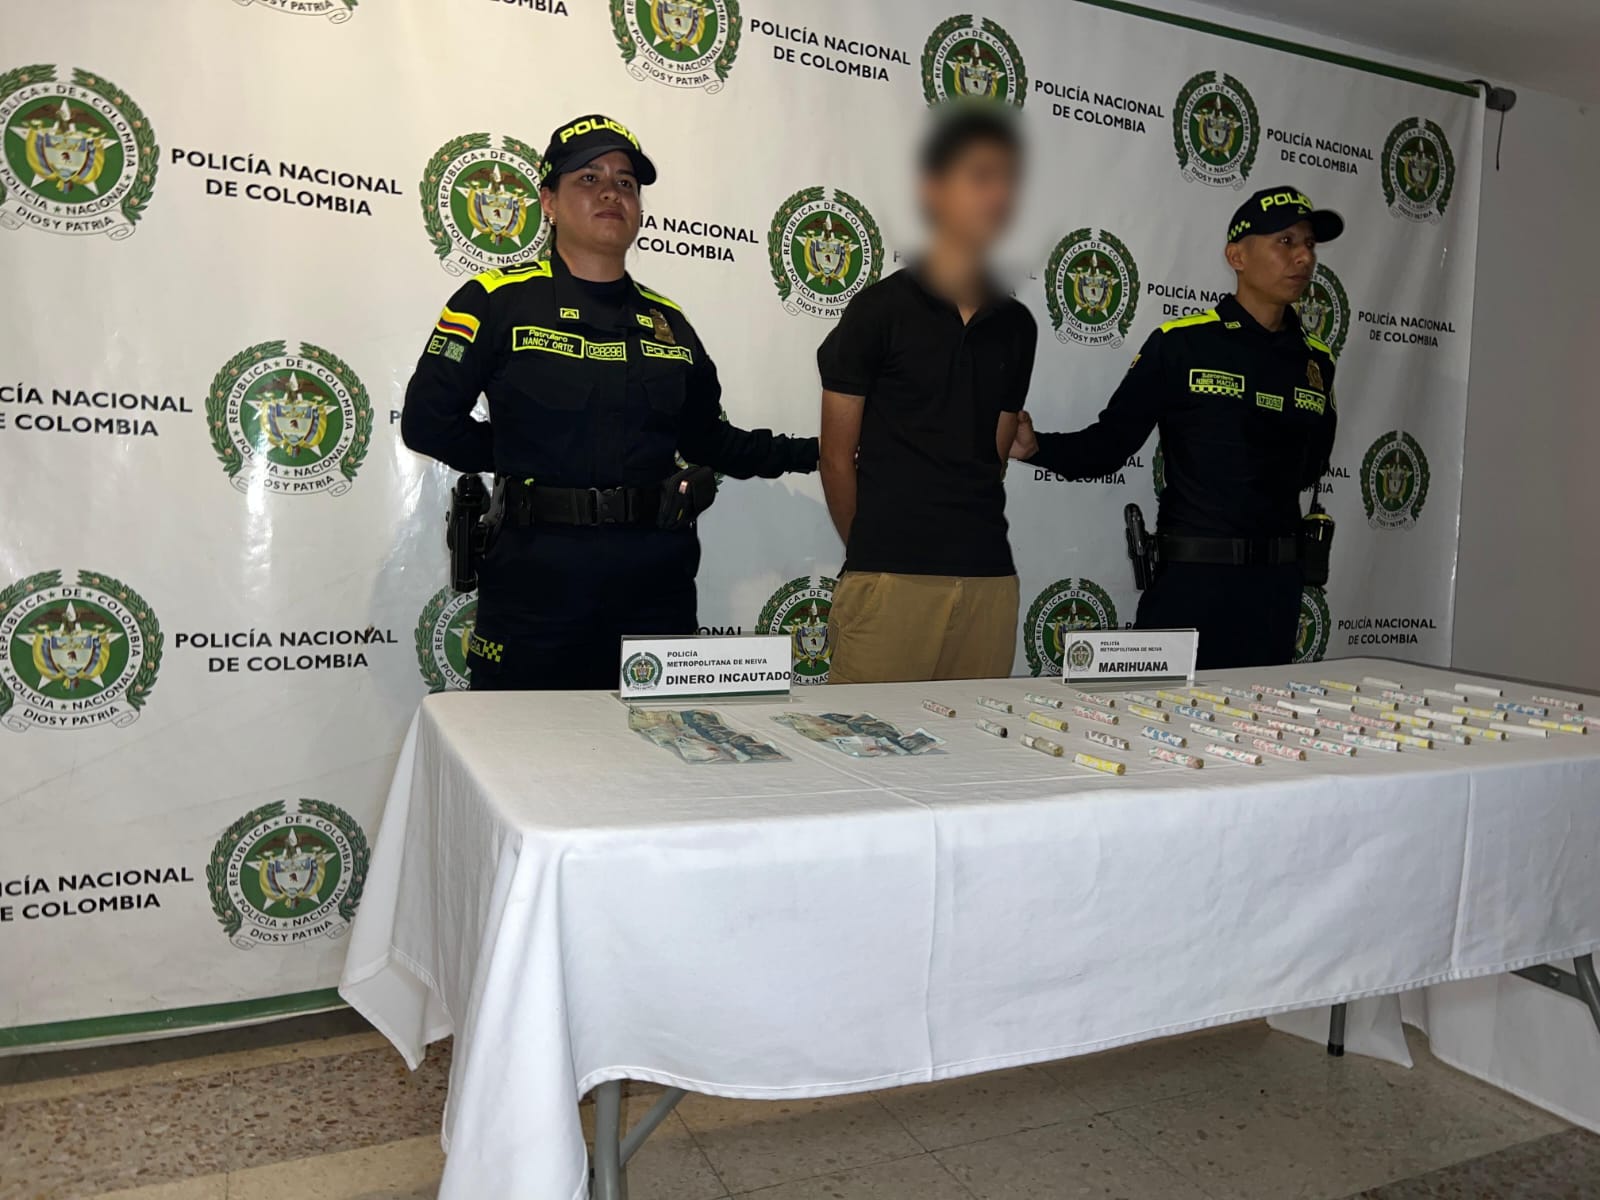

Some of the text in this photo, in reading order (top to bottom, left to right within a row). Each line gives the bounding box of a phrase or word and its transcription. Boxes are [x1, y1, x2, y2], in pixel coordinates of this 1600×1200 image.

[751, 19, 911, 66] POLICÍA NACIONAL
[676, 45, 722, 72] NACIONAL
[773, 46, 889, 81] DE COLOMBIA
[971, 30, 985, 39] DE
[992, 40, 1015, 93] COLOMBIA
[642, 61, 666, 81] DIOS
[676, 73, 710, 86] PATRIA
[1035, 80, 1165, 118] POLICÍA NACIONAL
[1052, 104, 1146, 133] DE COLOMBIA
[1215, 84, 1225, 92] DE
[1230, 93, 1250, 141] COLOMBIA
[56, 84, 77, 96] DE
[92, 97, 136, 168] COLOMBIA
[490, 150, 506, 161] DE
[1267, 128, 1374, 160] POLICÍA NACIONAL
[172, 148, 403, 195] POLICÍA NACIONAL
[1214, 151, 1246, 173] NACIONAL
[1280, 150, 1358, 175] DE COLOMBIA
[66, 182, 129, 215] NACIONAL
[205, 179, 372, 216] DE COLOMBIA
[16, 205, 114, 232] DIOS Y PATRIA
[663, 218, 759, 244] NACIONAL
[824, 202, 837, 211] DE
[844, 211, 870, 266] COLOMBIA
[496, 236, 546, 265] NACIONAL
[637, 236, 735, 262] COLOMBIA
[1090, 241, 1102, 249] DE
[1108, 249, 1129, 298] COLOMBIA
[825, 278, 867, 303] NACIONAL
[1147, 283, 1196, 301] POLICÍA
[1091, 308, 1124, 332] NACIONAL
[1163, 304, 1179, 316] DE
[1358, 311, 1455, 333] POLICÍA NACIONAL
[522, 336, 575, 354] NANCY ORTIZ
[1089, 332, 1114, 344] PATRIA
[1369, 329, 1438, 347] DE COLOMBIA
[51, 389, 193, 413] NACIONAL
[228, 358, 354, 430] REPUBLICA DE COLOMBIA
[14, 414, 160, 436] COLOMBIA
[294, 443, 348, 477] NACIONAL
[281, 482, 290, 491] Y
[293, 475, 335, 492] PATRIA
[809, 590, 823, 598] DE
[62, 588, 82, 597] DE
[97, 595, 141, 658] COLOMBIA
[1338, 616, 1437, 630] POLICÍA NACIONAL
[175, 629, 399, 648] POLICÍA NACIONAL
[1348, 633, 1418, 645] DE COLOMBIA
[208, 653, 369, 672] DE COLOMBIA
[667, 659, 731, 668] METROPOLITANA
[1098, 661, 1169, 673] MARIHUANA
[72, 671, 135, 711] NACIONAL
[666, 674, 715, 685] DINERO
[719, 671, 791, 684] INCAUTADO
[23, 705, 120, 726] DIOS Y PATRIA
[229, 816, 352, 886] REPUBLICA DE COLOMBIA
[0, 867, 194, 897] ICÍA NACIONAL
[0, 893, 161, 921] E COLOMBIA
[292, 887, 346, 926] NACIONAL
[250, 920, 334, 942] DIOS Y PATRIA
